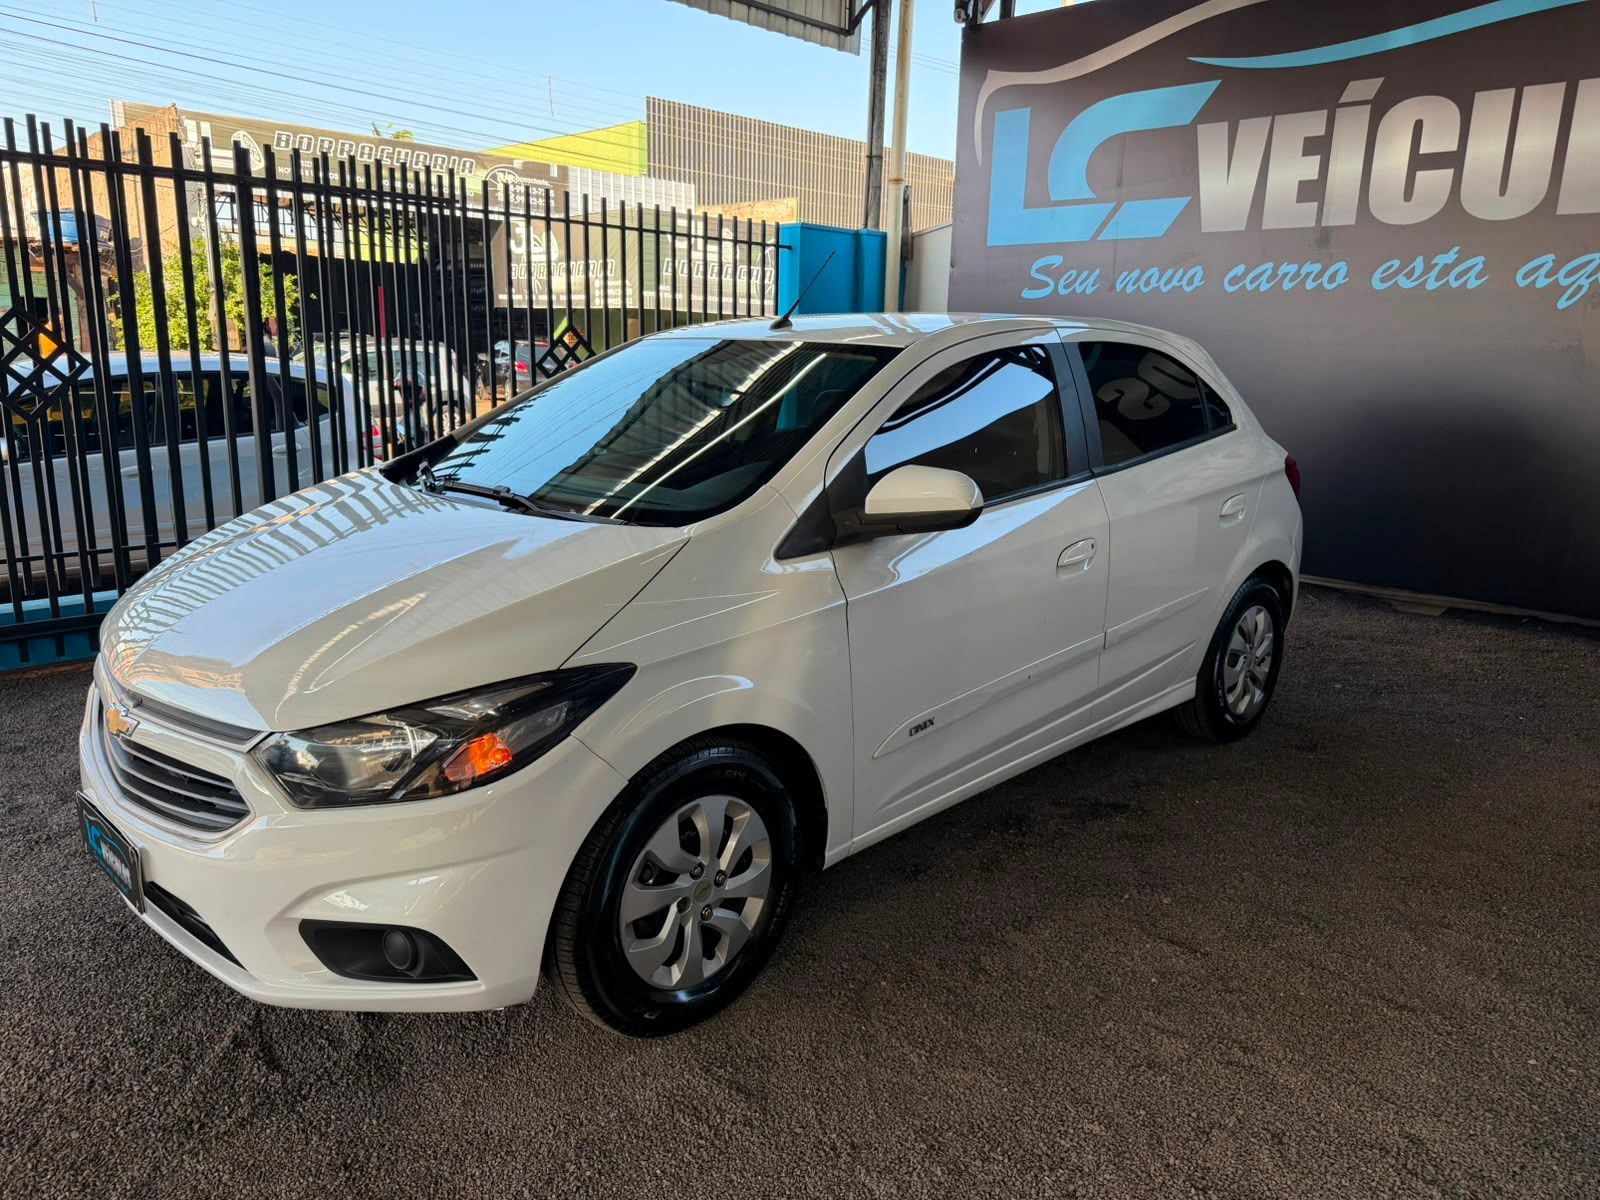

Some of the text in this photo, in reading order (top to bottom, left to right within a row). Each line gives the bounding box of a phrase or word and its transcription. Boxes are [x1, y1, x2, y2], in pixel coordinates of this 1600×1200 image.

[273, 130, 476, 175] BORRACHARIA
[986, 79, 1223, 247] LC
[1021, 246, 1600, 310] Seu novo carro esta aq
[909, 716, 936, 737] ONIX
